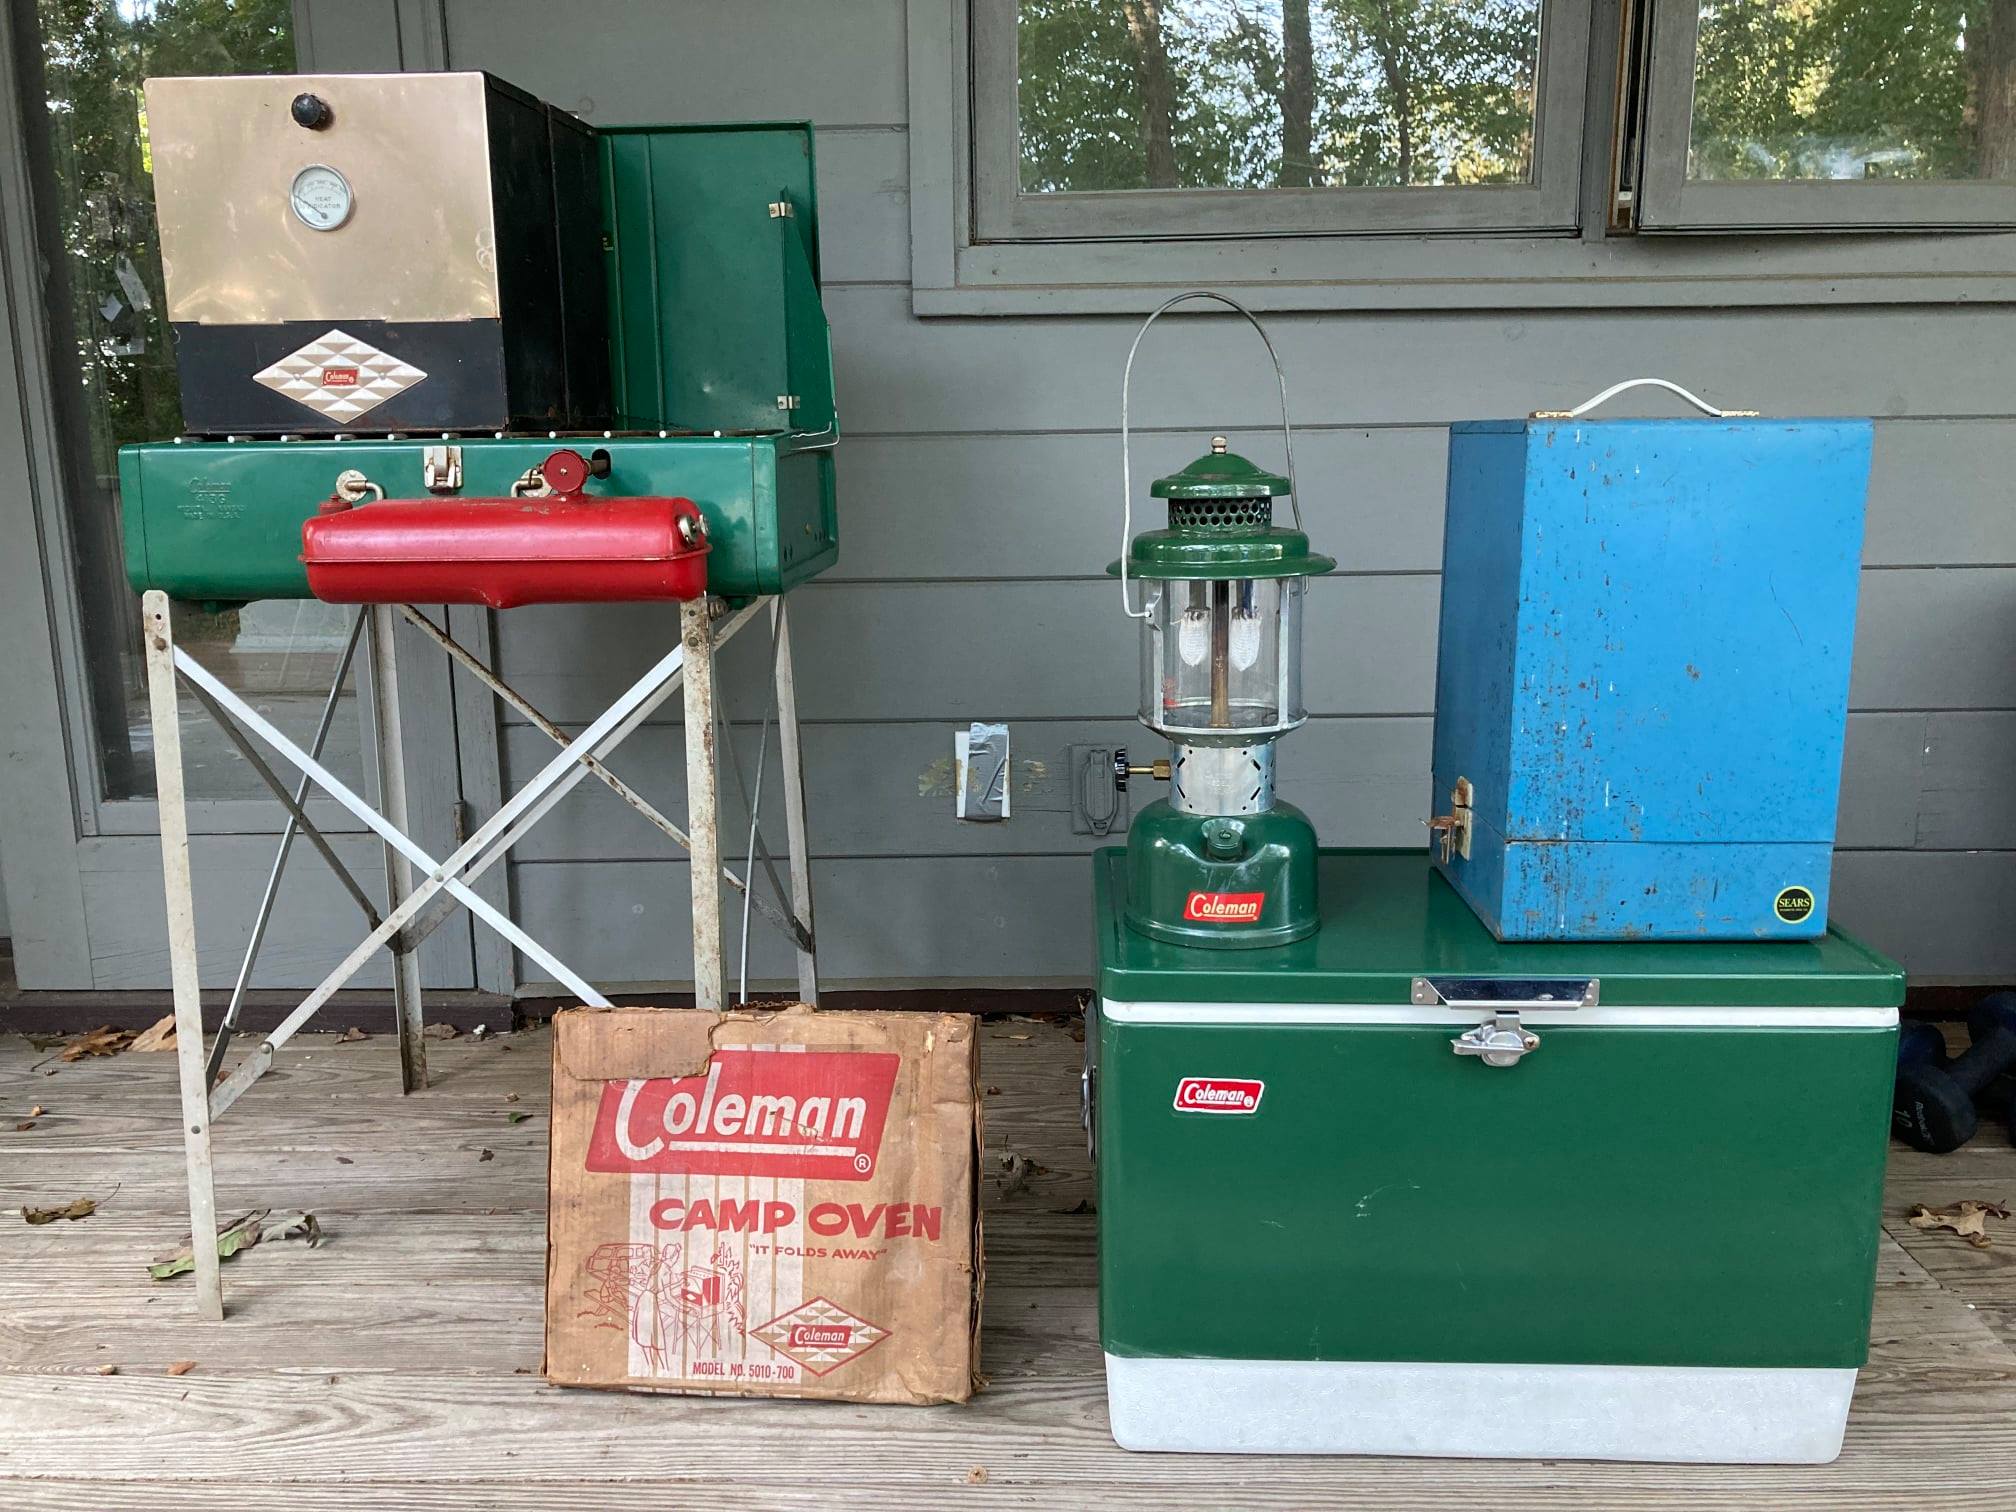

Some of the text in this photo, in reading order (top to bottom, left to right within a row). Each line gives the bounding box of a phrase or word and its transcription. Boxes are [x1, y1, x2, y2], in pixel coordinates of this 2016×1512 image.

[325, 371, 350, 382] Coleman
[1190, 893, 1258, 918] Coleman
[1778, 897, 1811, 908] SEARS
[1183, 1082, 1246, 1105] Coleman
[614, 1061, 867, 1161] Coleman
[648, 1197, 943, 1242] CAMP OVEN
[774, 1246, 828, 1259] FOLDS
[794, 1326, 846, 1345] Coleman
[692, 1361, 726, 1376] MODEL
[749, 1364, 795, 1380] 5010-700
